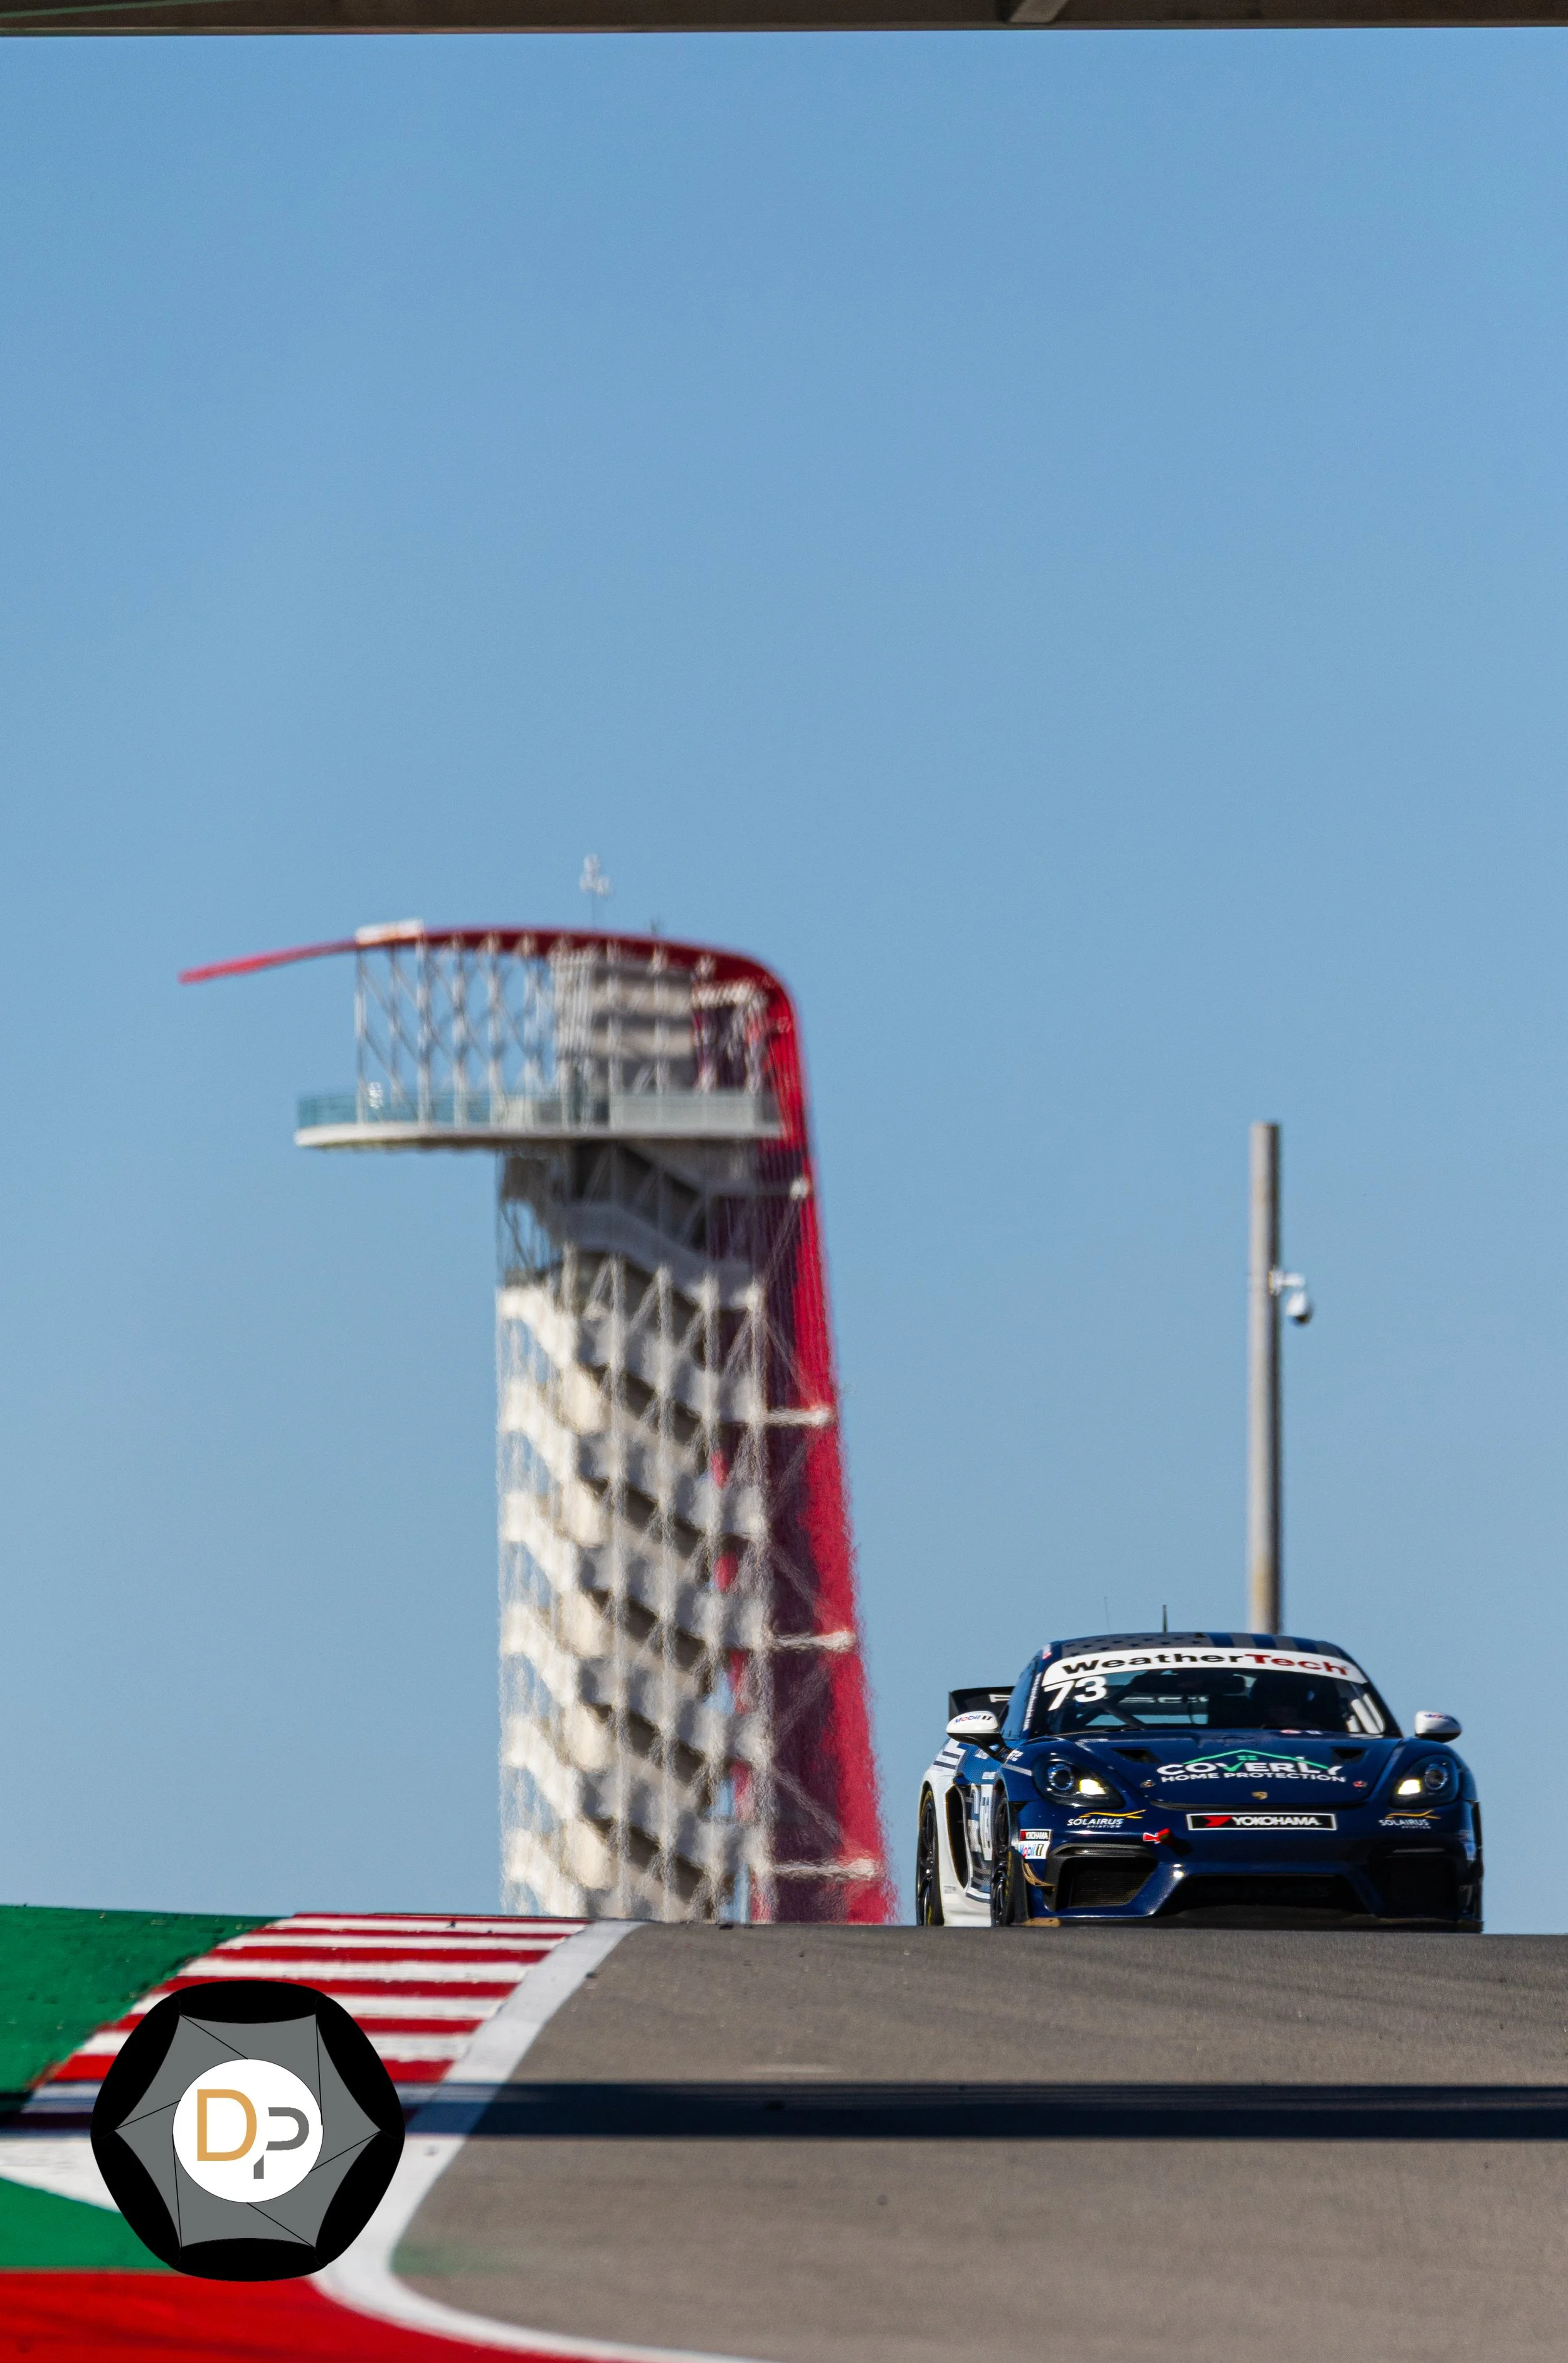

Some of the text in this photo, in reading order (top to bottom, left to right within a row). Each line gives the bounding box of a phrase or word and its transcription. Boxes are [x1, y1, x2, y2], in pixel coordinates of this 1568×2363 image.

[1062, 1653, 1347, 1676] WeatherTech
[1044, 1675, 1107, 1711] 73
[1162, 1771, 1347, 1783] HOME PROTECTION
[1231, 1816, 1321, 1826] YOKOHAMA
